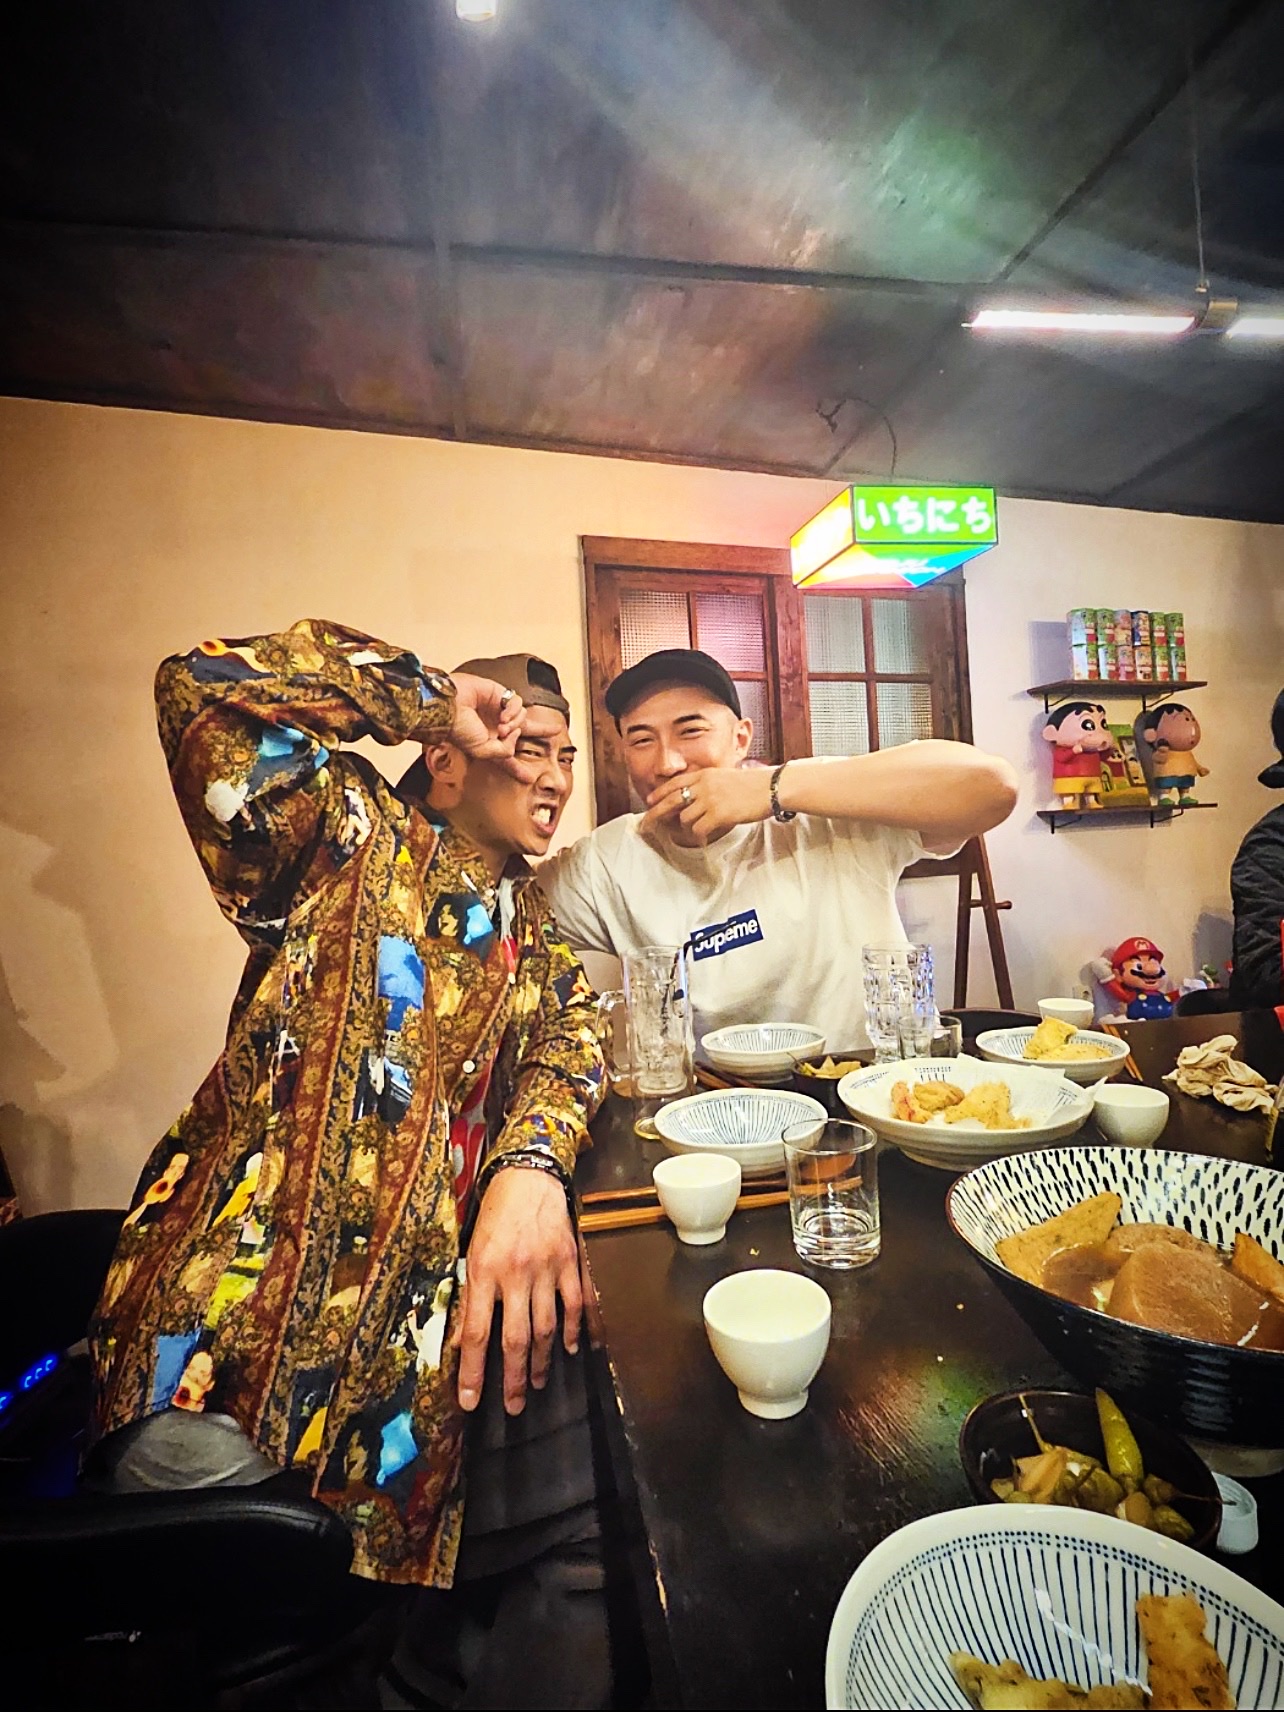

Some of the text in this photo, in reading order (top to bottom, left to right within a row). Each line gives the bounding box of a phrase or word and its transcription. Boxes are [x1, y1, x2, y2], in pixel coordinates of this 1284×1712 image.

[858, 495, 992, 534] いちにち
[694, 919, 758, 953] Supeme
